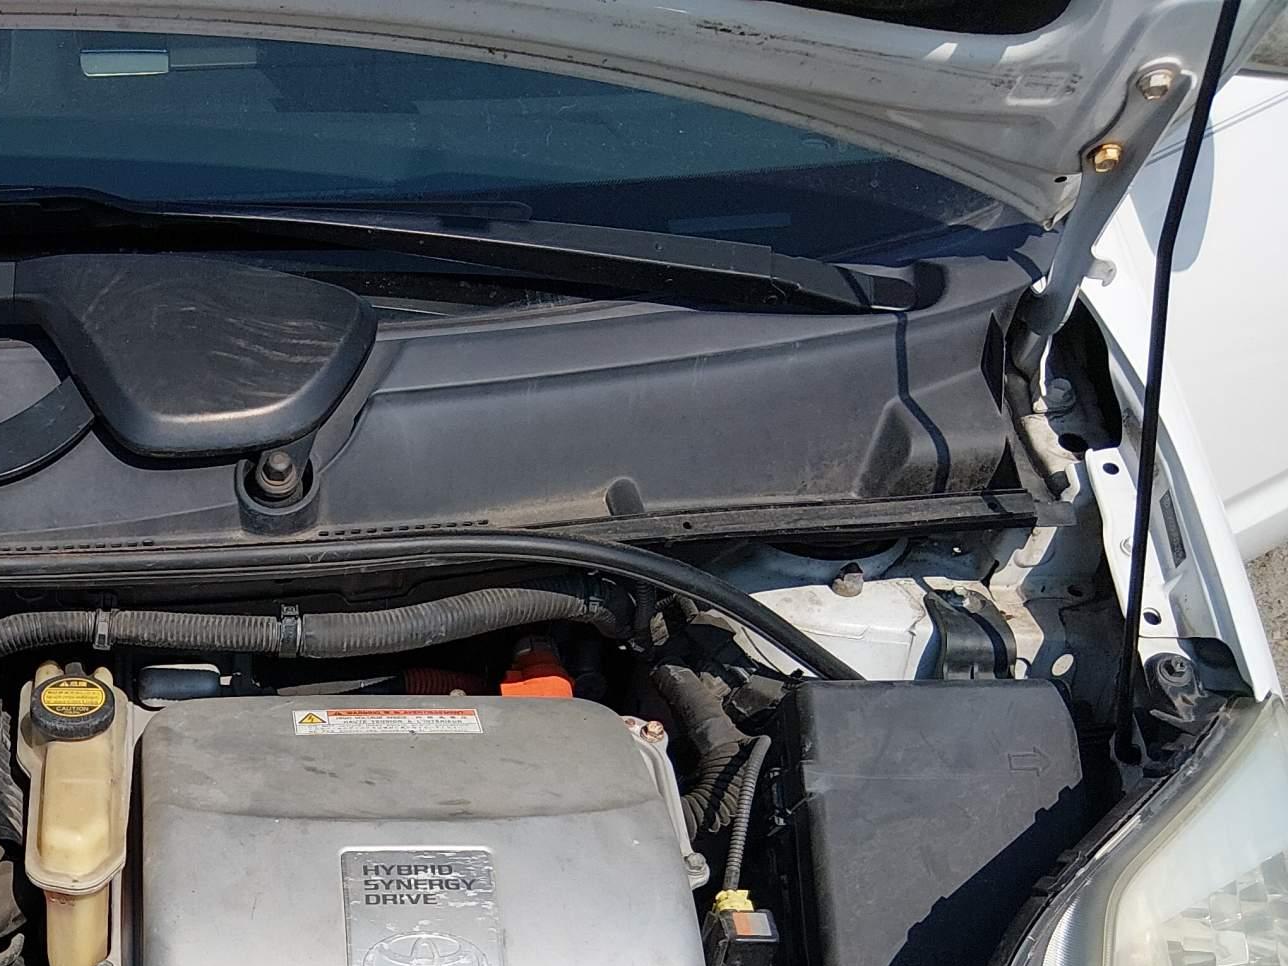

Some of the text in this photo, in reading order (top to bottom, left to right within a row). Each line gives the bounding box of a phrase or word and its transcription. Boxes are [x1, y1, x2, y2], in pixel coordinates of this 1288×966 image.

[362, 864, 453, 876] HYBRID
[364, 879, 476, 891] SYNERGY
[365, 894, 438, 905] DRIVE
